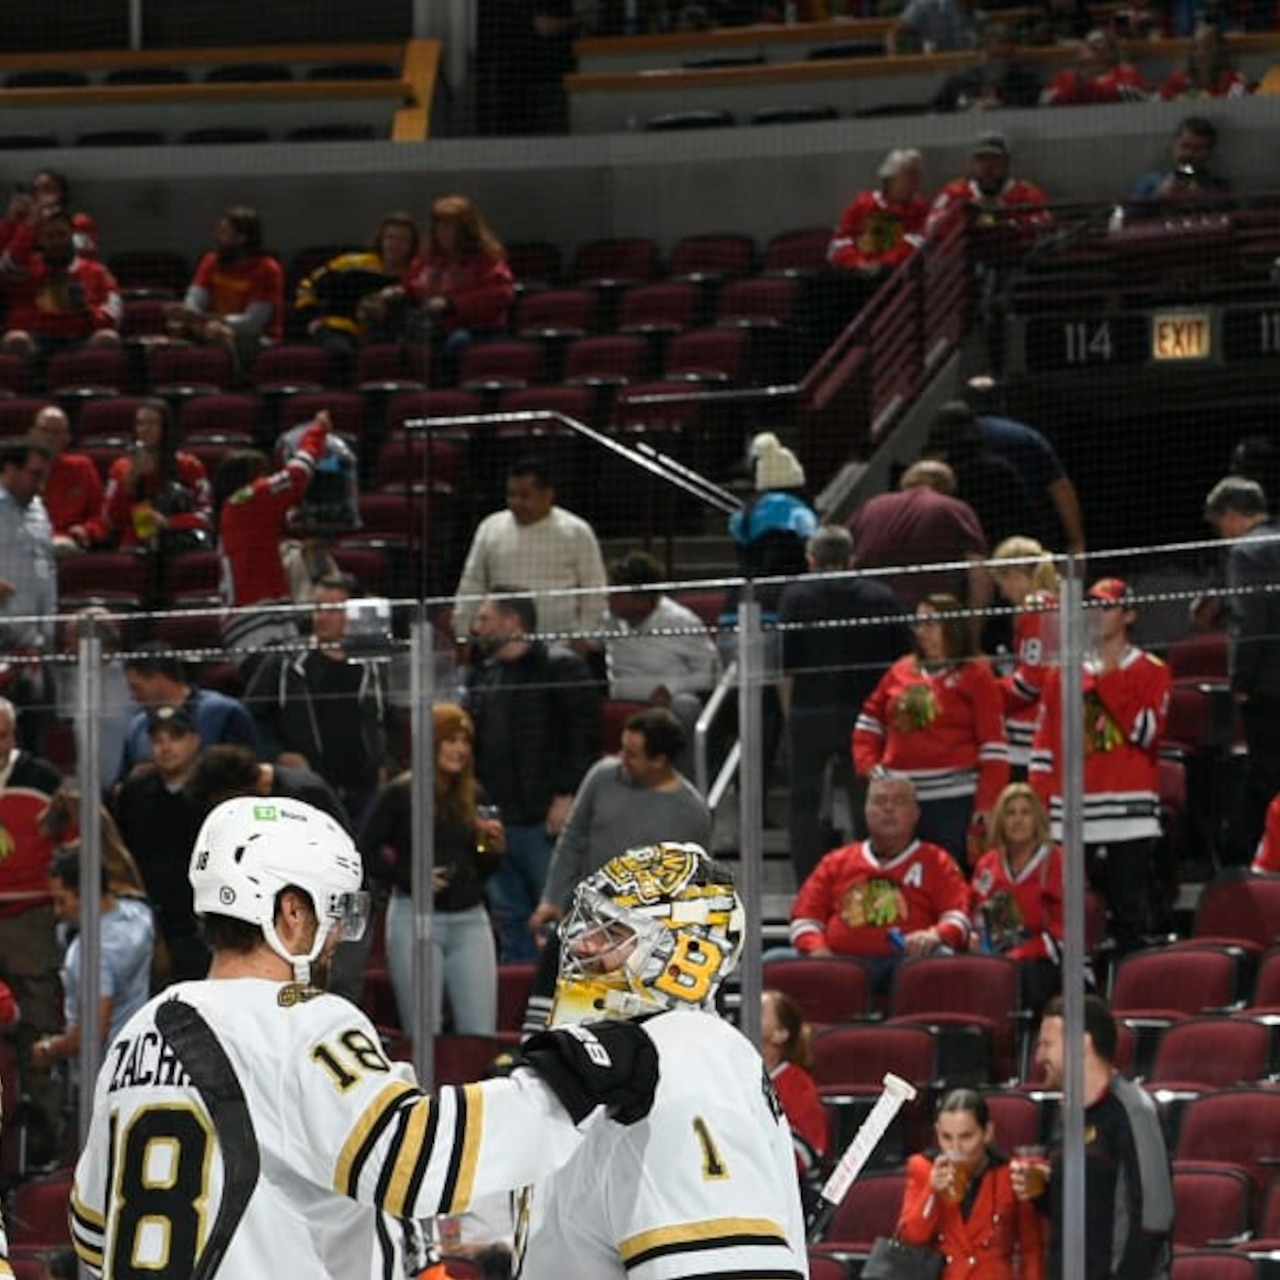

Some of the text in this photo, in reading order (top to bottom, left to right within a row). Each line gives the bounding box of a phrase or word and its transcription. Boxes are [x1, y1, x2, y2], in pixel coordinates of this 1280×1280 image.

[1065, 322, 1112, 361] 114
[1159, 320, 1207, 357] EXIT
[903, 863, 923, 887] A
[308, 1028, 391, 1094] 18
[690, 1114, 730, 1183] 1
